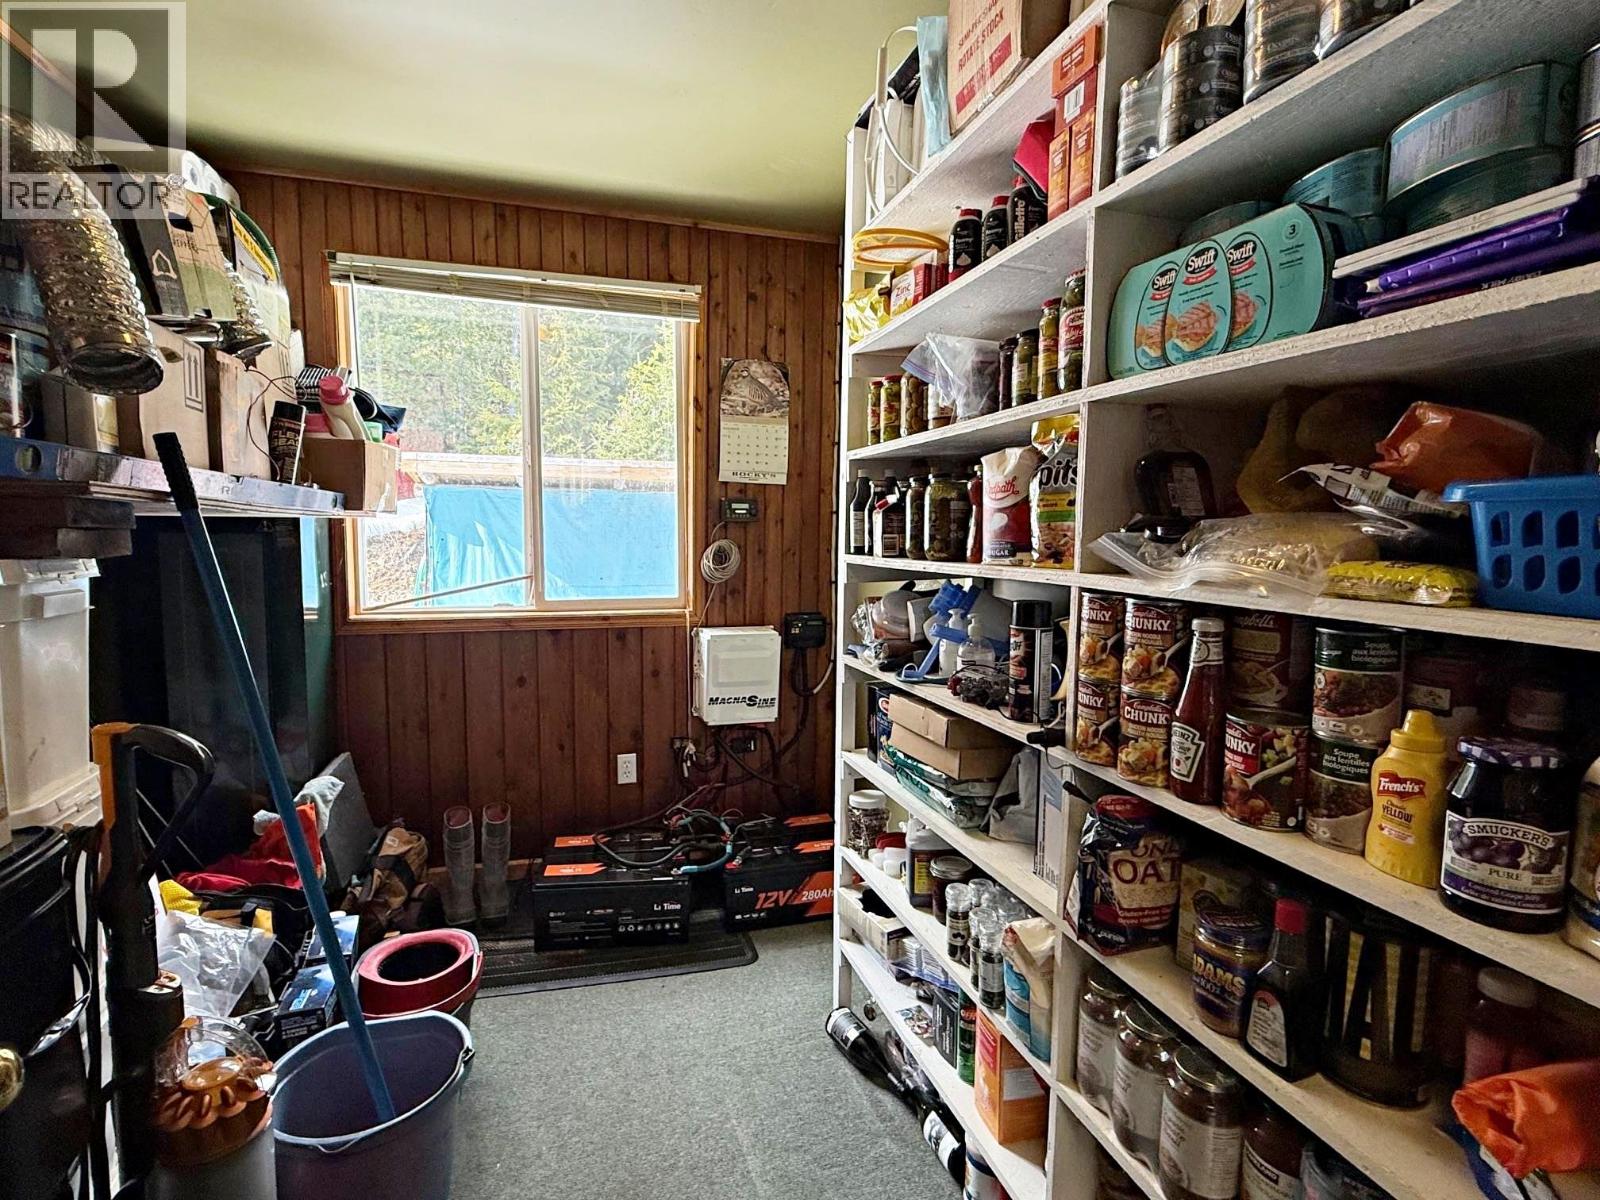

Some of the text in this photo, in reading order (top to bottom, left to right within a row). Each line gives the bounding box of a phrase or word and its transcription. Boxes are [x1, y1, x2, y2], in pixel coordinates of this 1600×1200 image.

[981, 7, 1004, 44] STOCK
[1288, 224, 1296, 235] 3
[1227, 240, 1255, 262] Swift
[1187, 249, 1217, 272] Swift
[1124, 706, 1170, 725] CHUNK
[1334, 748, 1360, 759] Soupe
[1338, 755, 1369, 767] lentilles
[1323, 760, 1369, 774] biologiques
[1379, 777, 1420, 792] French's
[1382, 804, 1414, 823] YELLOW
[1487, 867, 1521, 880] PURE
[663, 902, 681, 911] Time
[755, 888, 834, 910] 12V 280Ah
[1193, 953, 1247, 997] DAMS
